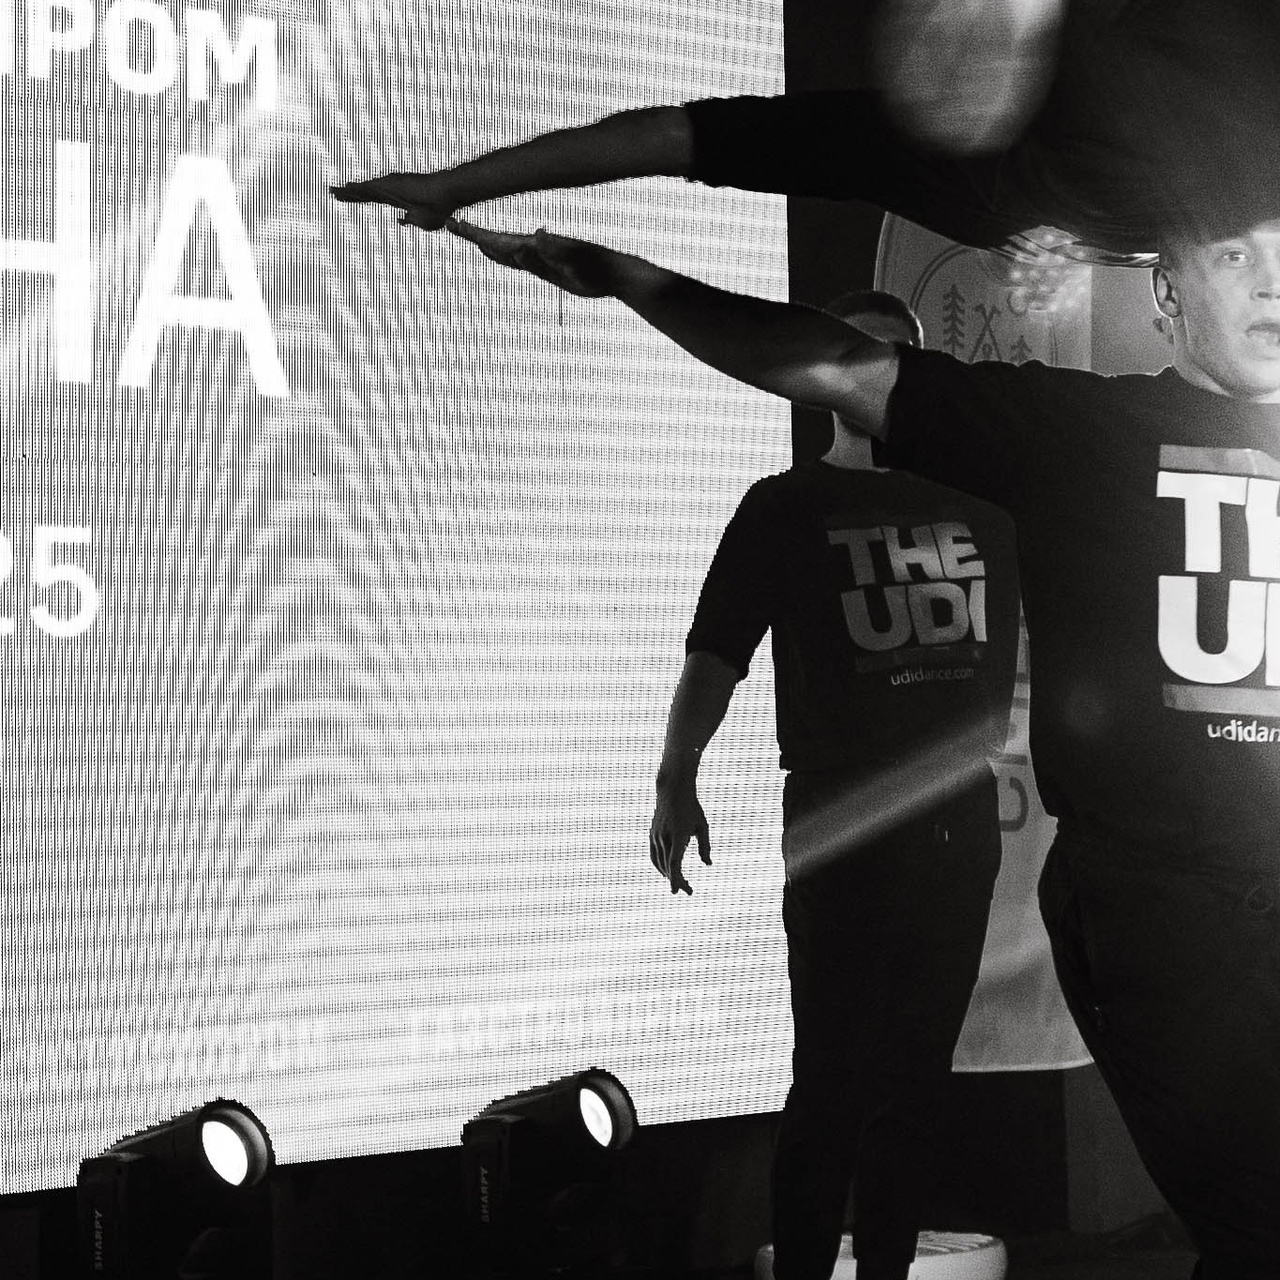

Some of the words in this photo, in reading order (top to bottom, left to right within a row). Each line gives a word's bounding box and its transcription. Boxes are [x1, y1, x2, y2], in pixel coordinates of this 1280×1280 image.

[0, 522, 100, 637] 5
[826, 521, 985, 587] THE
[840, 579, 988, 652] UDI
[890, 665, 975, 687] udidance.com
[479, 1165, 489, 1223] SHARPY
[94, 1207, 103, 1271] SHARPY
